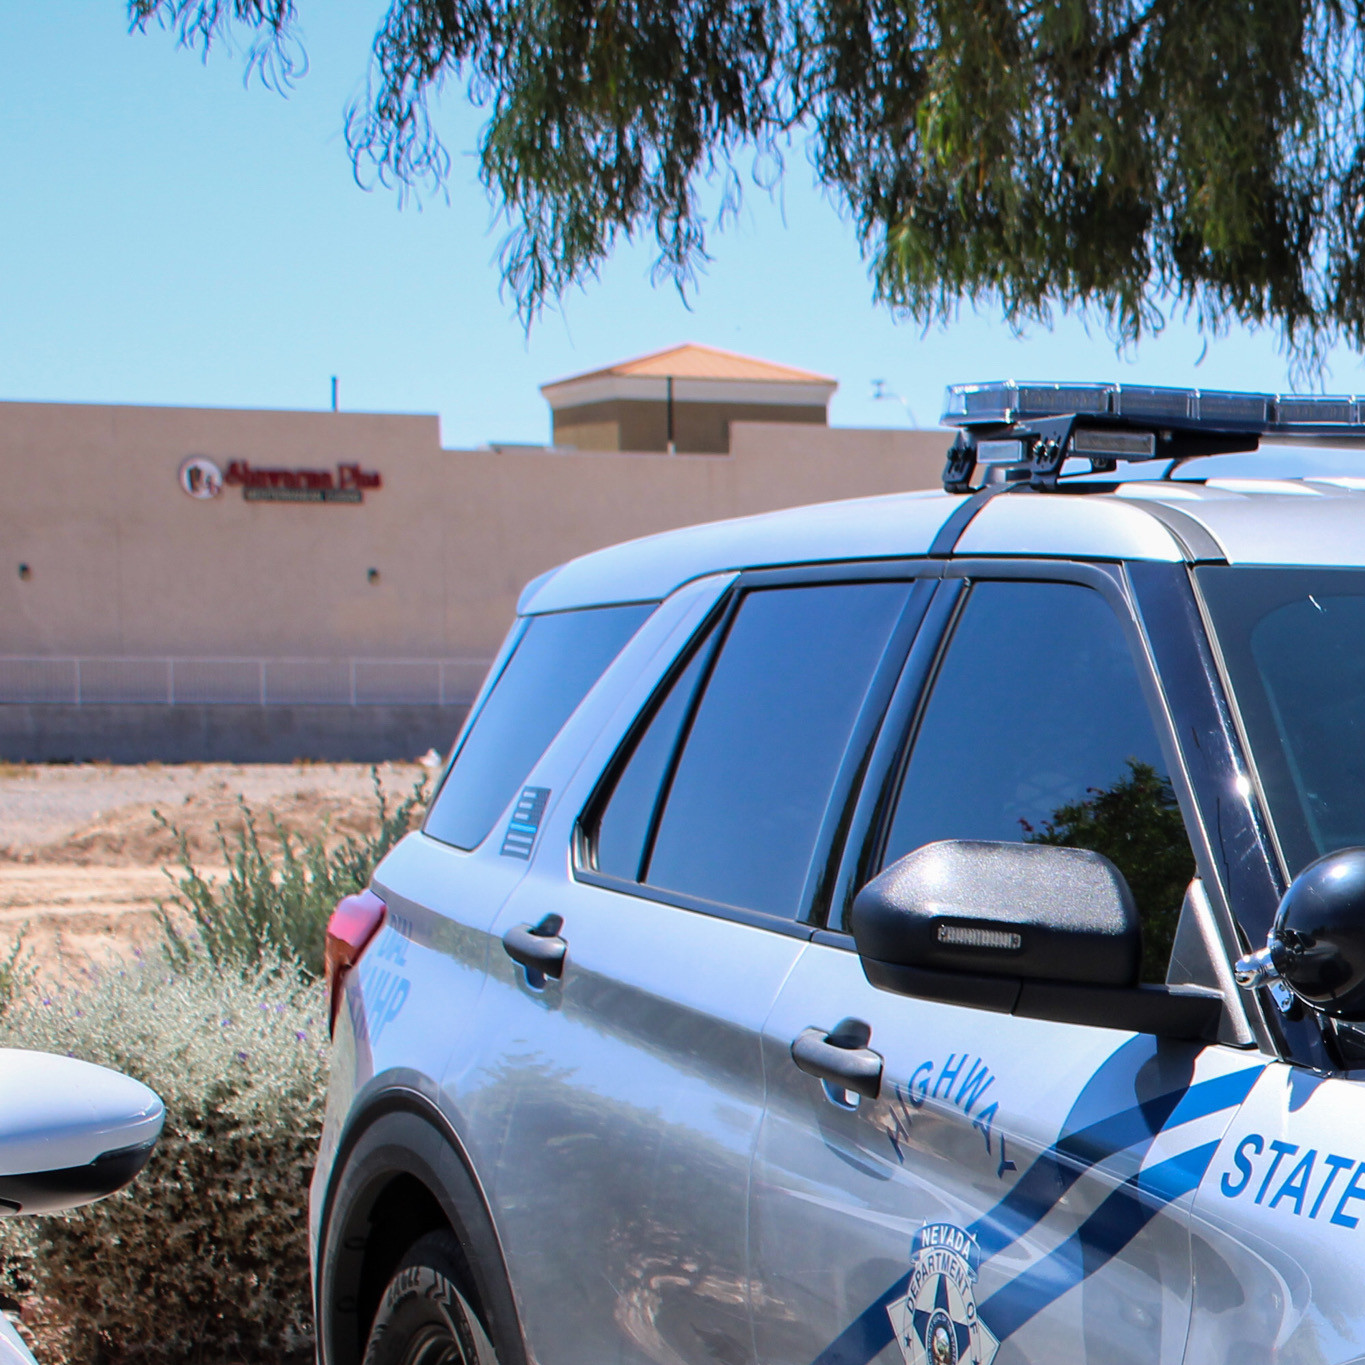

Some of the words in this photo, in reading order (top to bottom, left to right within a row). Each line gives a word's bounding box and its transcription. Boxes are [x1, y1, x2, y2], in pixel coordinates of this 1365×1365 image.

[886, 1053, 1018, 1179] HIGHWAY
[921, 1226, 972, 1259] NEVADA
[906, 1252, 969, 1313] DEPARTMENT
[966, 1302, 978, 1334] OF
